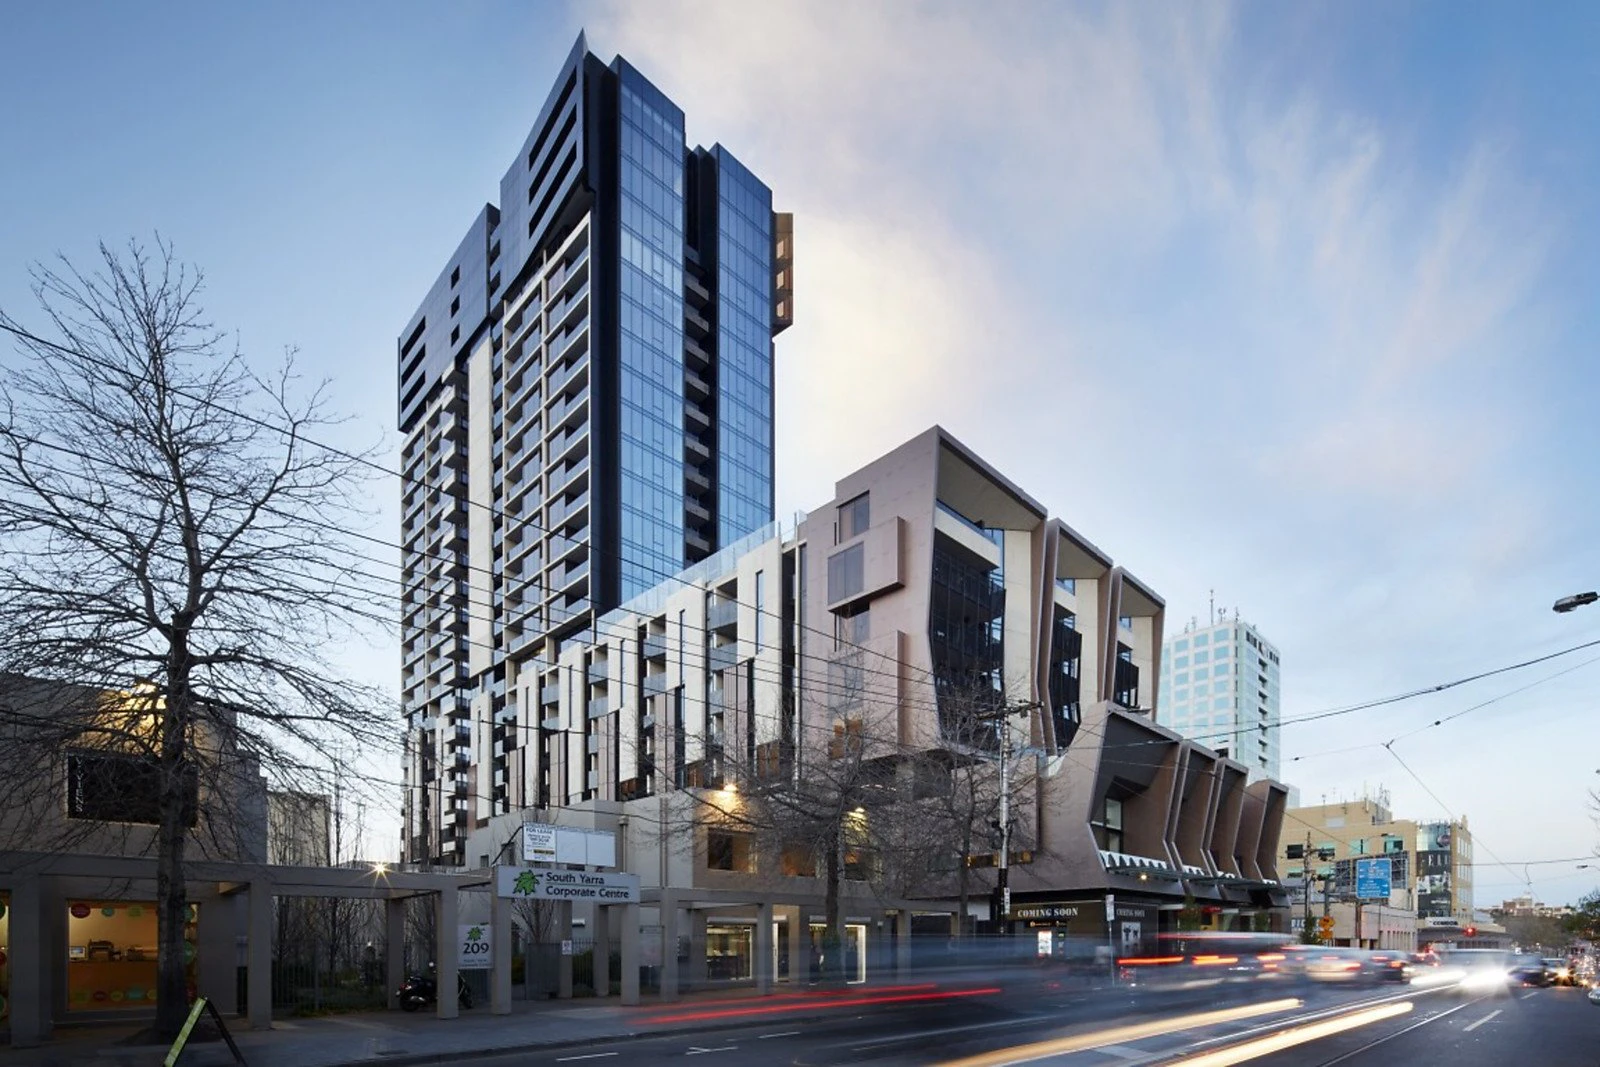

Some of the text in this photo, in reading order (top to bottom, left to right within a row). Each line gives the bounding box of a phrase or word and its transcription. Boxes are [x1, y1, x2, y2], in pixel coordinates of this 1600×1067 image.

[546, 871, 605, 885] South Yarra
[546, 886, 630, 899] Corporate Centre
[1017, 907, 1079, 918] COMING SOON
[463, 942, 490, 954] 209
